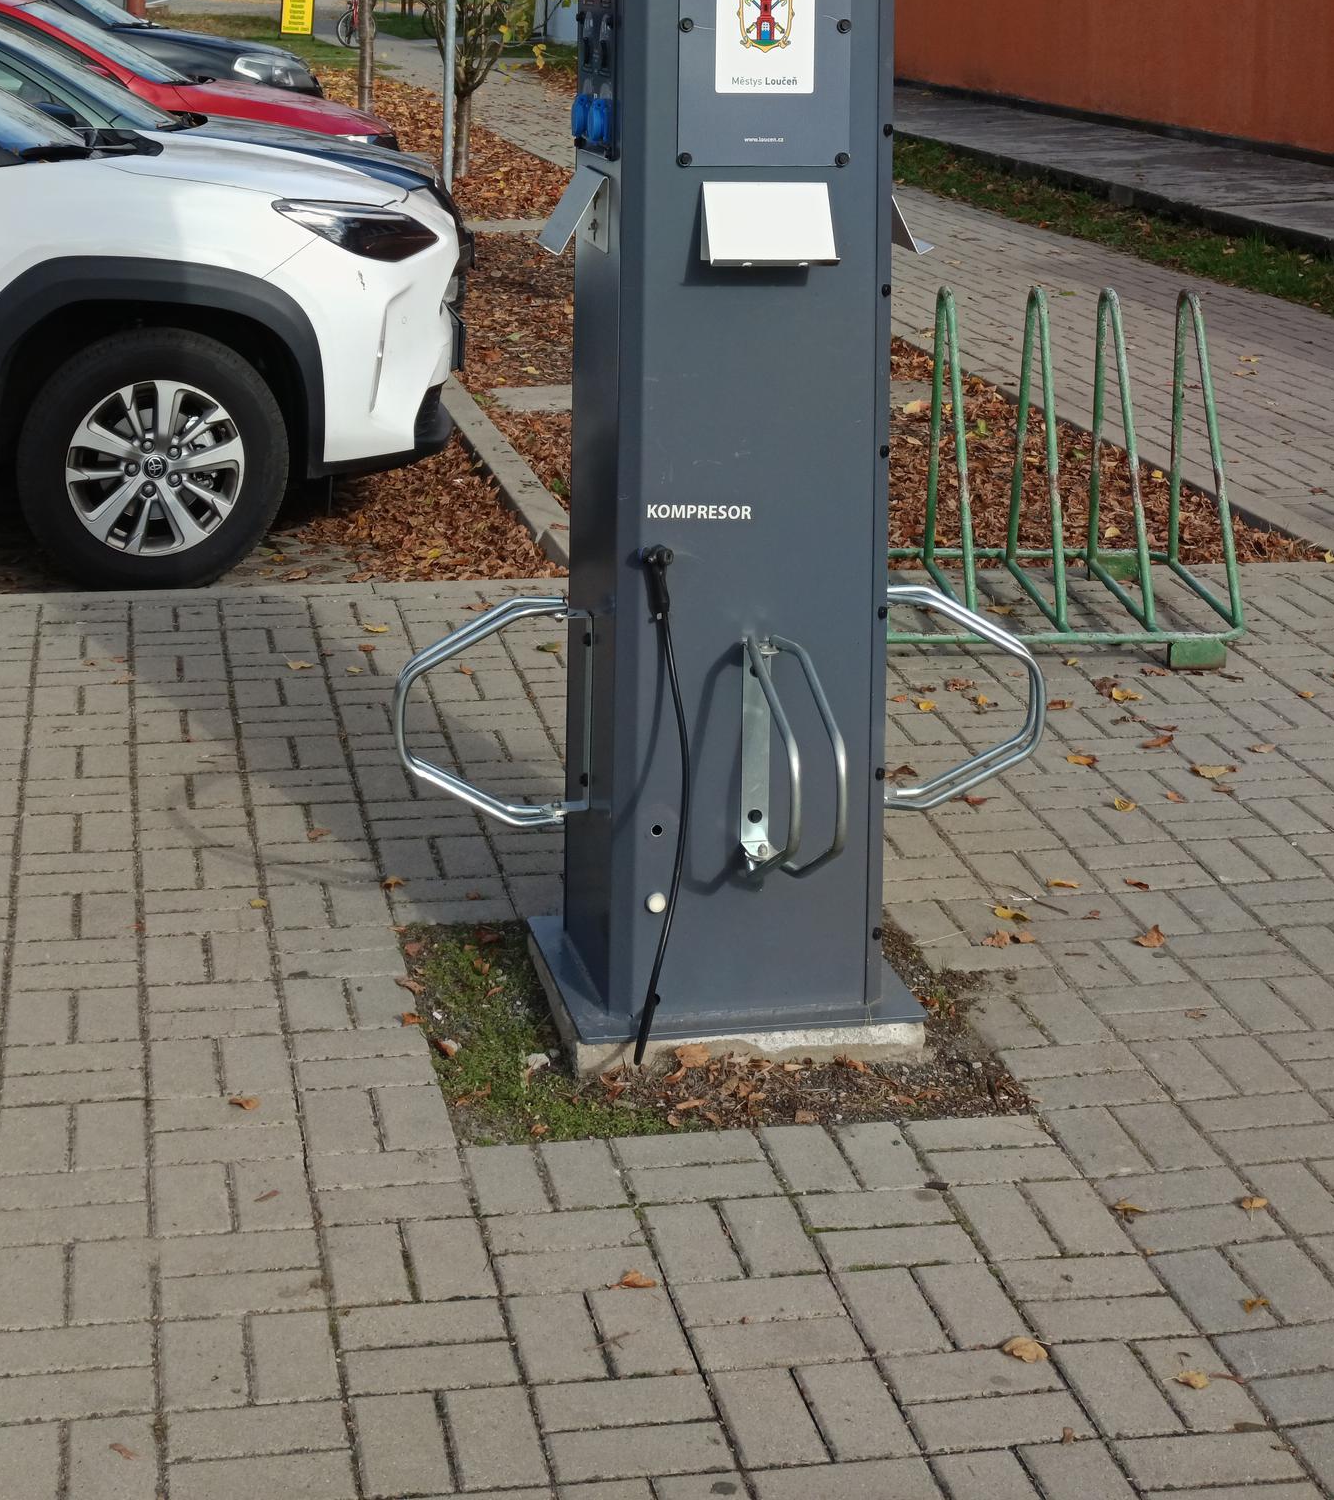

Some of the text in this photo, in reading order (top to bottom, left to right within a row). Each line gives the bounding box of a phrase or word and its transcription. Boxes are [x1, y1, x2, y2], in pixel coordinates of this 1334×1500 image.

[731, 76, 798, 87] Městys Loučeň
[646, 504, 752, 520] KOMPRESOR
